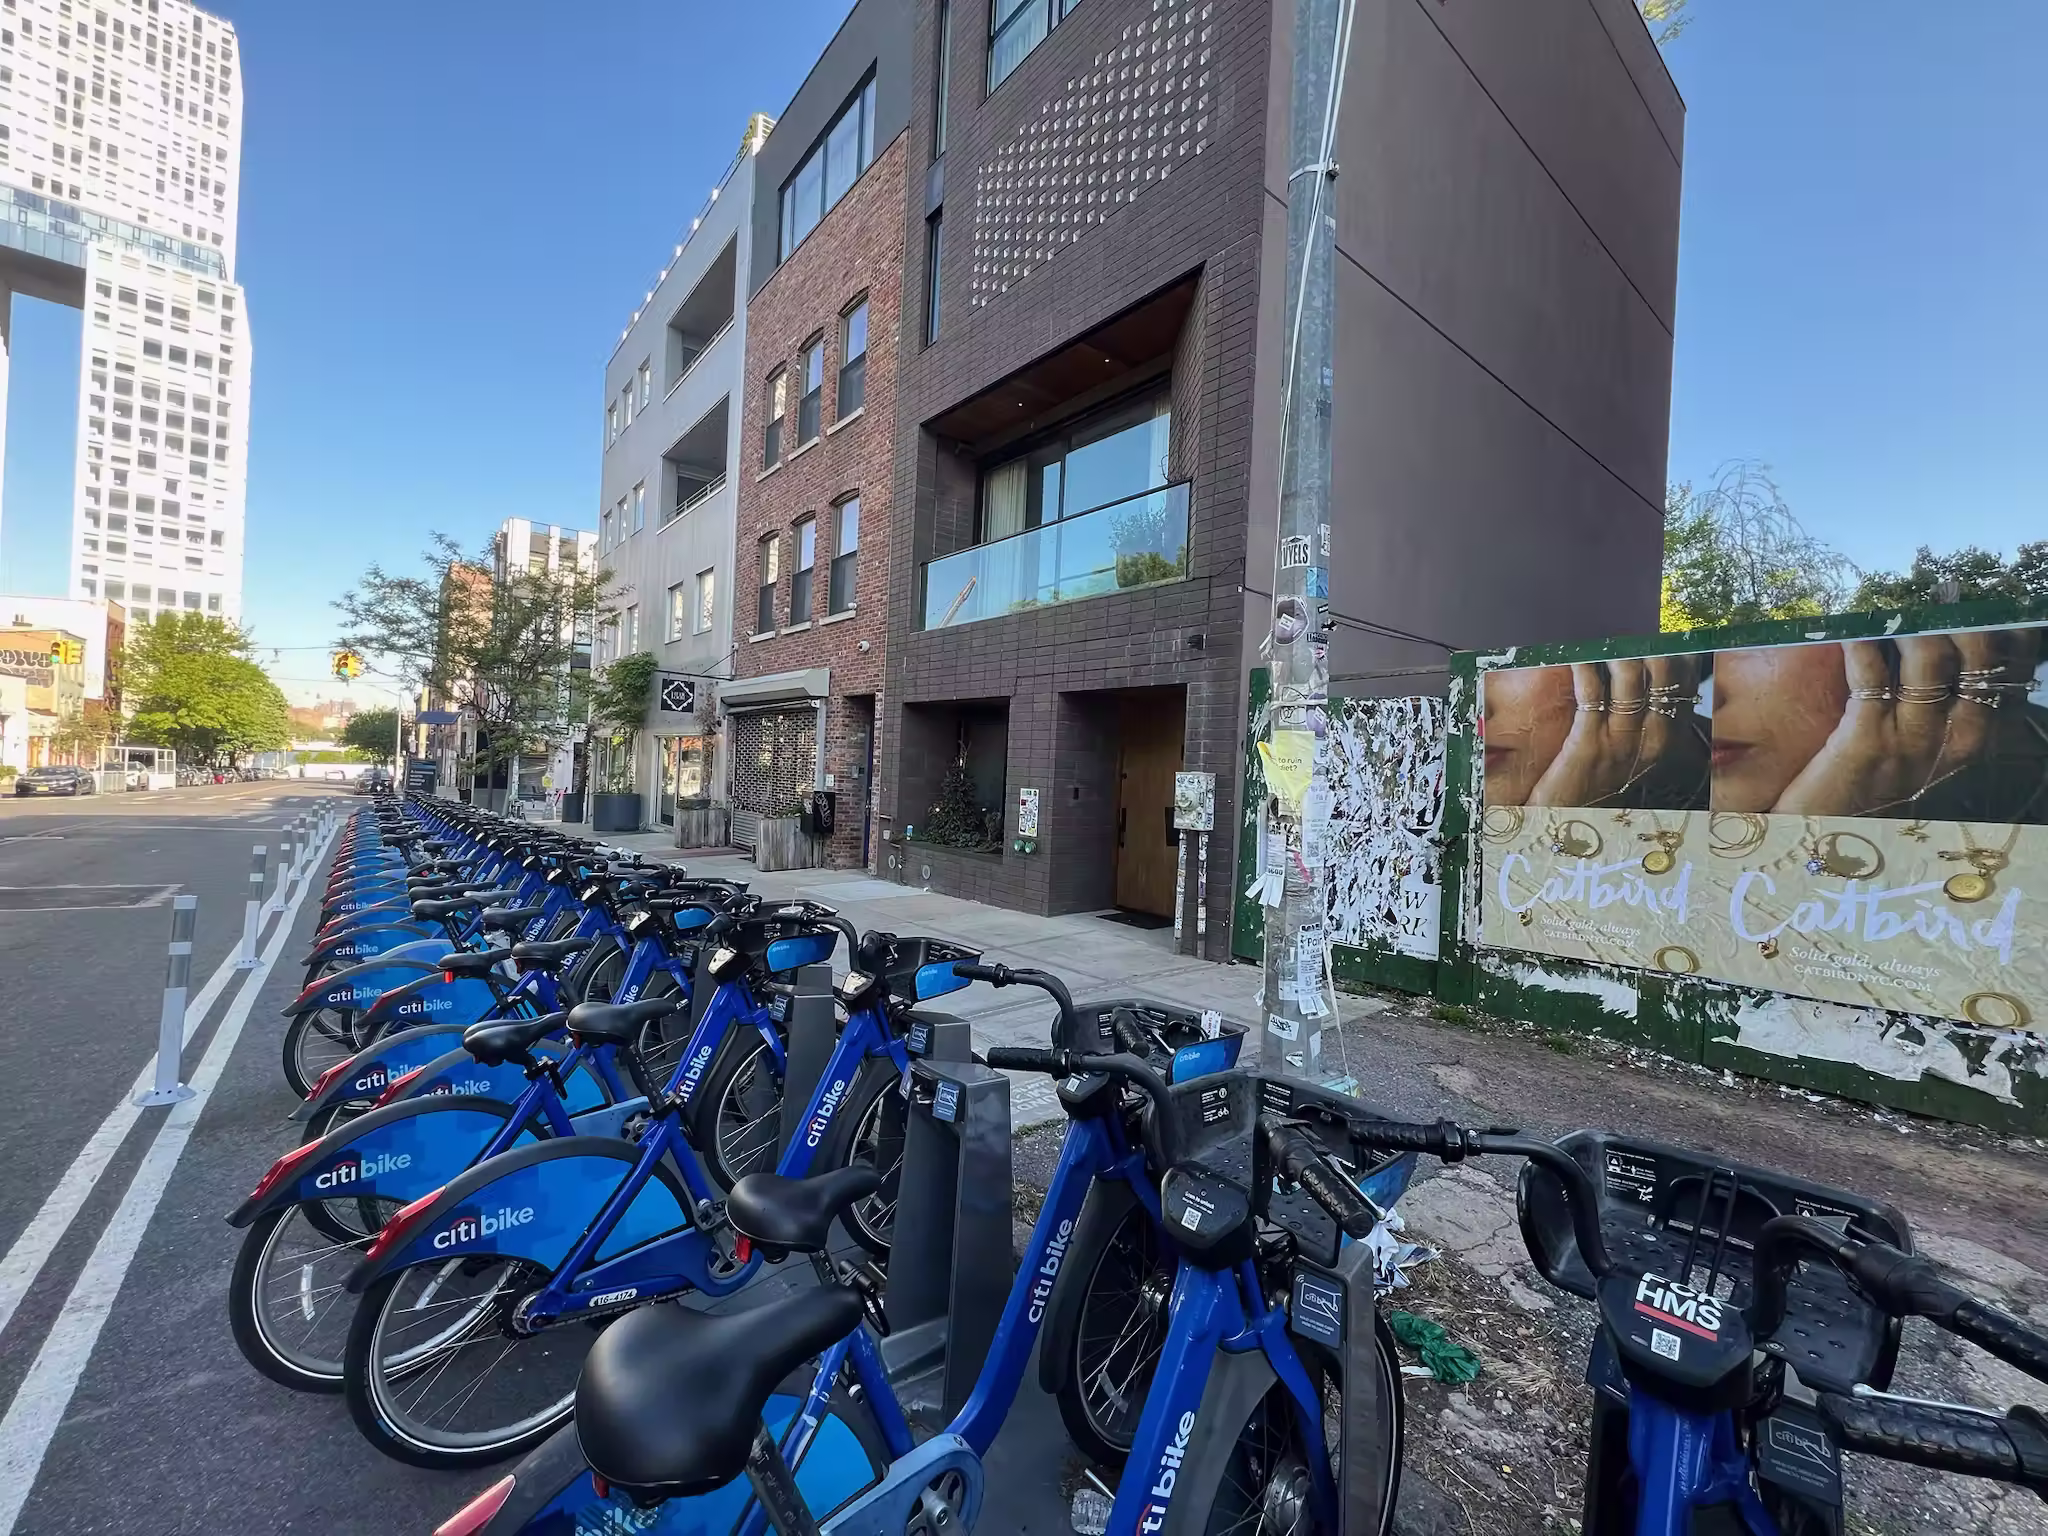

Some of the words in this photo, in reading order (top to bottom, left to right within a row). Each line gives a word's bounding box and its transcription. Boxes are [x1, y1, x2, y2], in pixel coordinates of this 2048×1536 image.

[1498, 853, 1693, 925] Catbird
[356, 902, 372, 910] bik
[1730, 871, 2022, 966] Catbird
[1540, 915, 1567, 927] Solid
[1600, 922, 1641, 938] always
[1543, 930, 1635, 948] CATBIRDNYC.COM
[335, 946, 354, 956] citi
[355, 944, 379, 954] bike
[1789, 946, 1830, 962] Solid
[1831, 952, 1874, 969] gold,
[1878, 958, 1942, 979] always
[623, 984, 639, 1004] ike
[1793, 964, 1933, 992] CATBIRDNYC.COM
[327, 990, 351, 1002] citi
[353, 987, 382, 999] bike
[399, 1002, 421, 1014] citi
[423, 999, 453, 1012] bike
[684, 1045, 713, 1080] bike
[355, 1070, 385, 1091] citi
[451, 1080, 491, 1096] bike
[817, 1080, 845, 1117] bike
[807, 1116, 828, 1147] citi
[315, 1161, 357, 1189] citi
[361, 1153, 412, 1179] bike
[433, 1217, 476, 1250] citi
[480, 1207, 534, 1236] bike
[1040, 1219, 1073, 1276] bike
[1028, 1279, 1053, 1323] citi
[1635, 1280, 1722, 1331] HMS
[1151, 1410, 1196, 1498] bike
